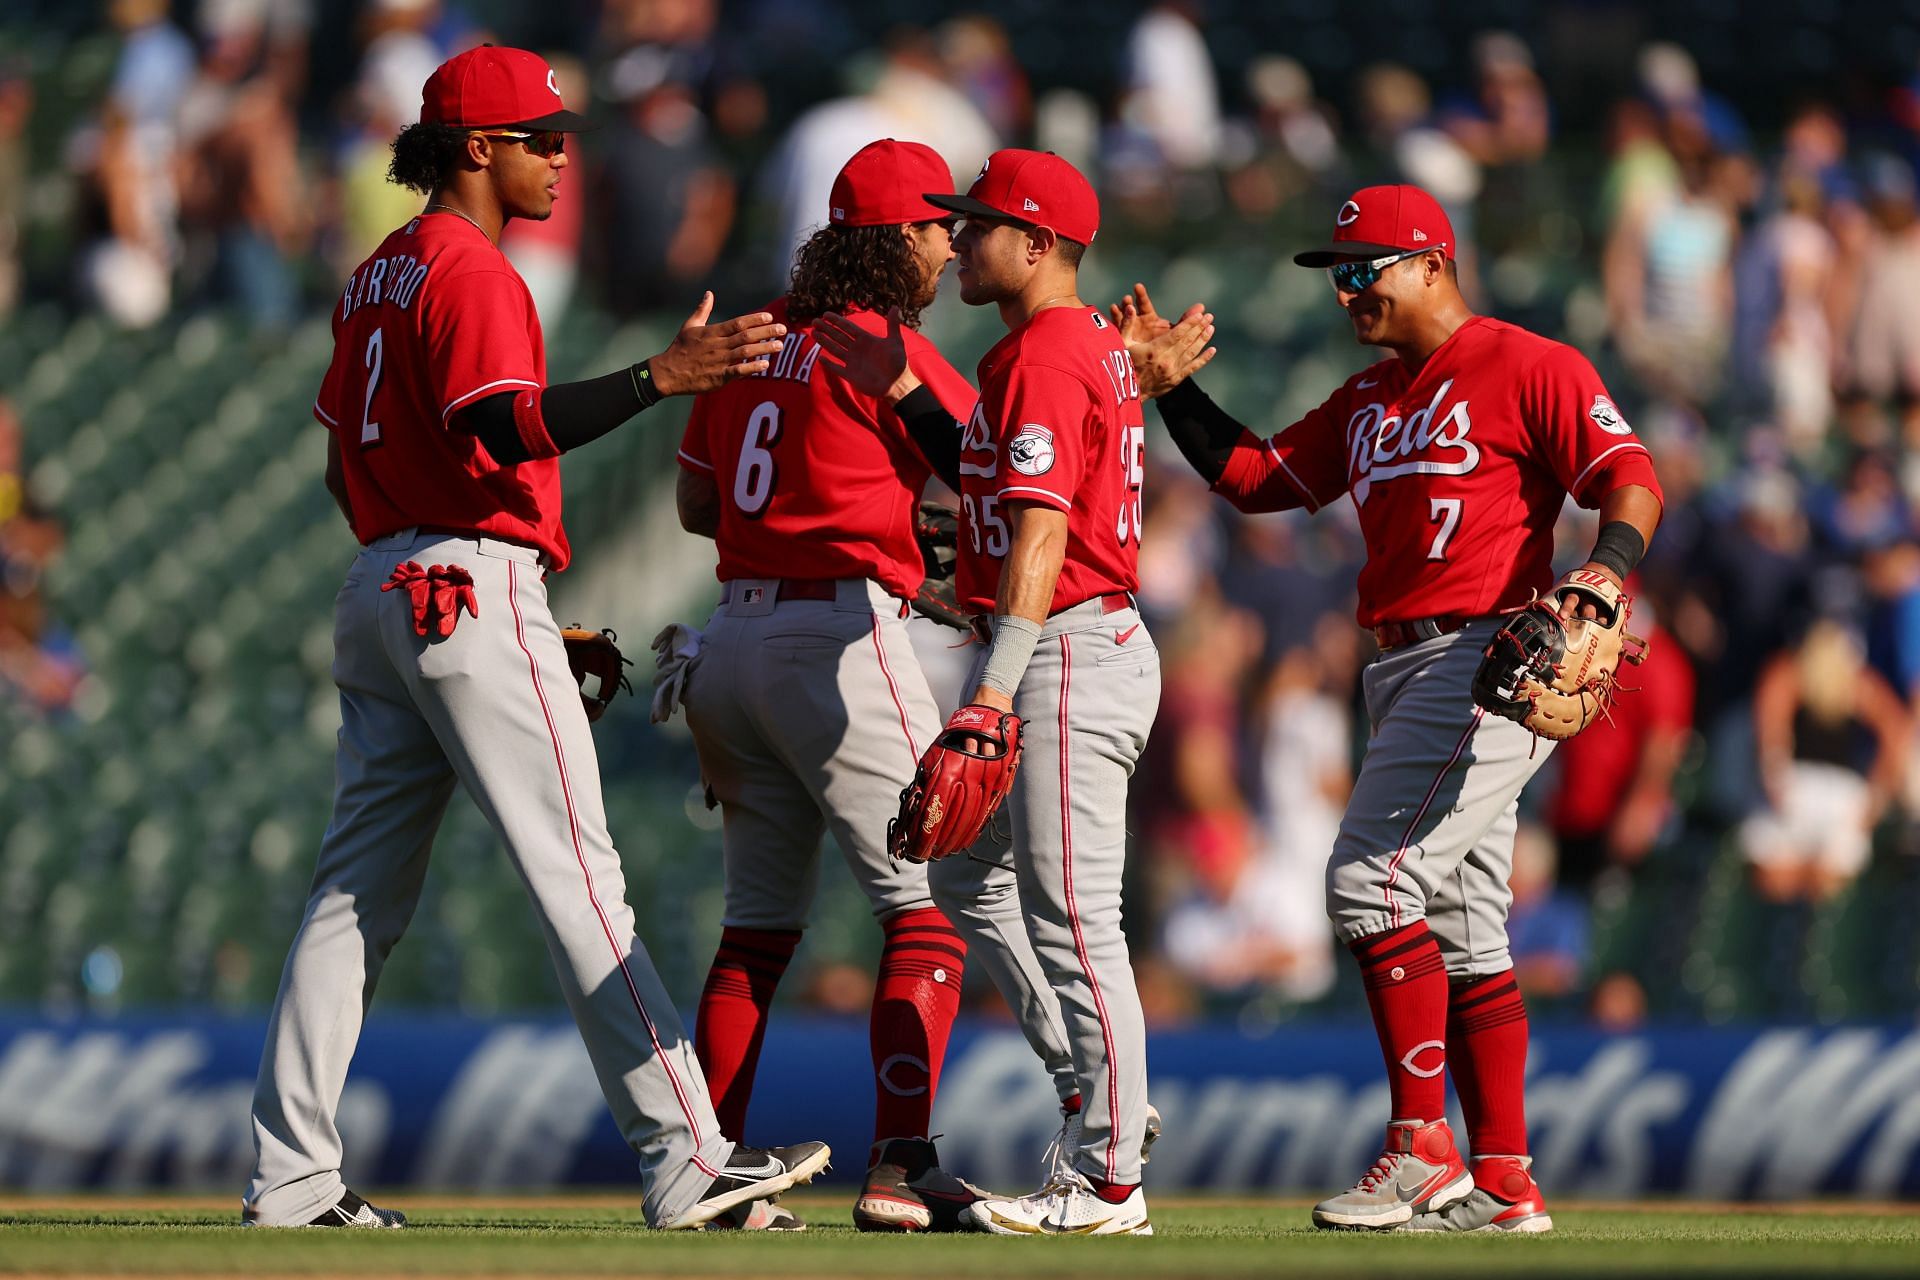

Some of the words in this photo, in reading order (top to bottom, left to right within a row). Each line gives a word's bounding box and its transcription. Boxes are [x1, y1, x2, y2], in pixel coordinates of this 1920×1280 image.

[1337, 200, 1360, 227] C
[361, 327, 383, 444] 2
[734, 400, 780, 514] 6
[1347, 378, 1480, 508] Reds
[1116, 424, 1144, 545] 35
[963, 493, 1010, 557] 35
[1427, 498, 1464, 562] 7
[1574, 631, 1599, 688] marucci
[878, 1052, 929, 1097] C
[1400, 1040, 1446, 1078] C
